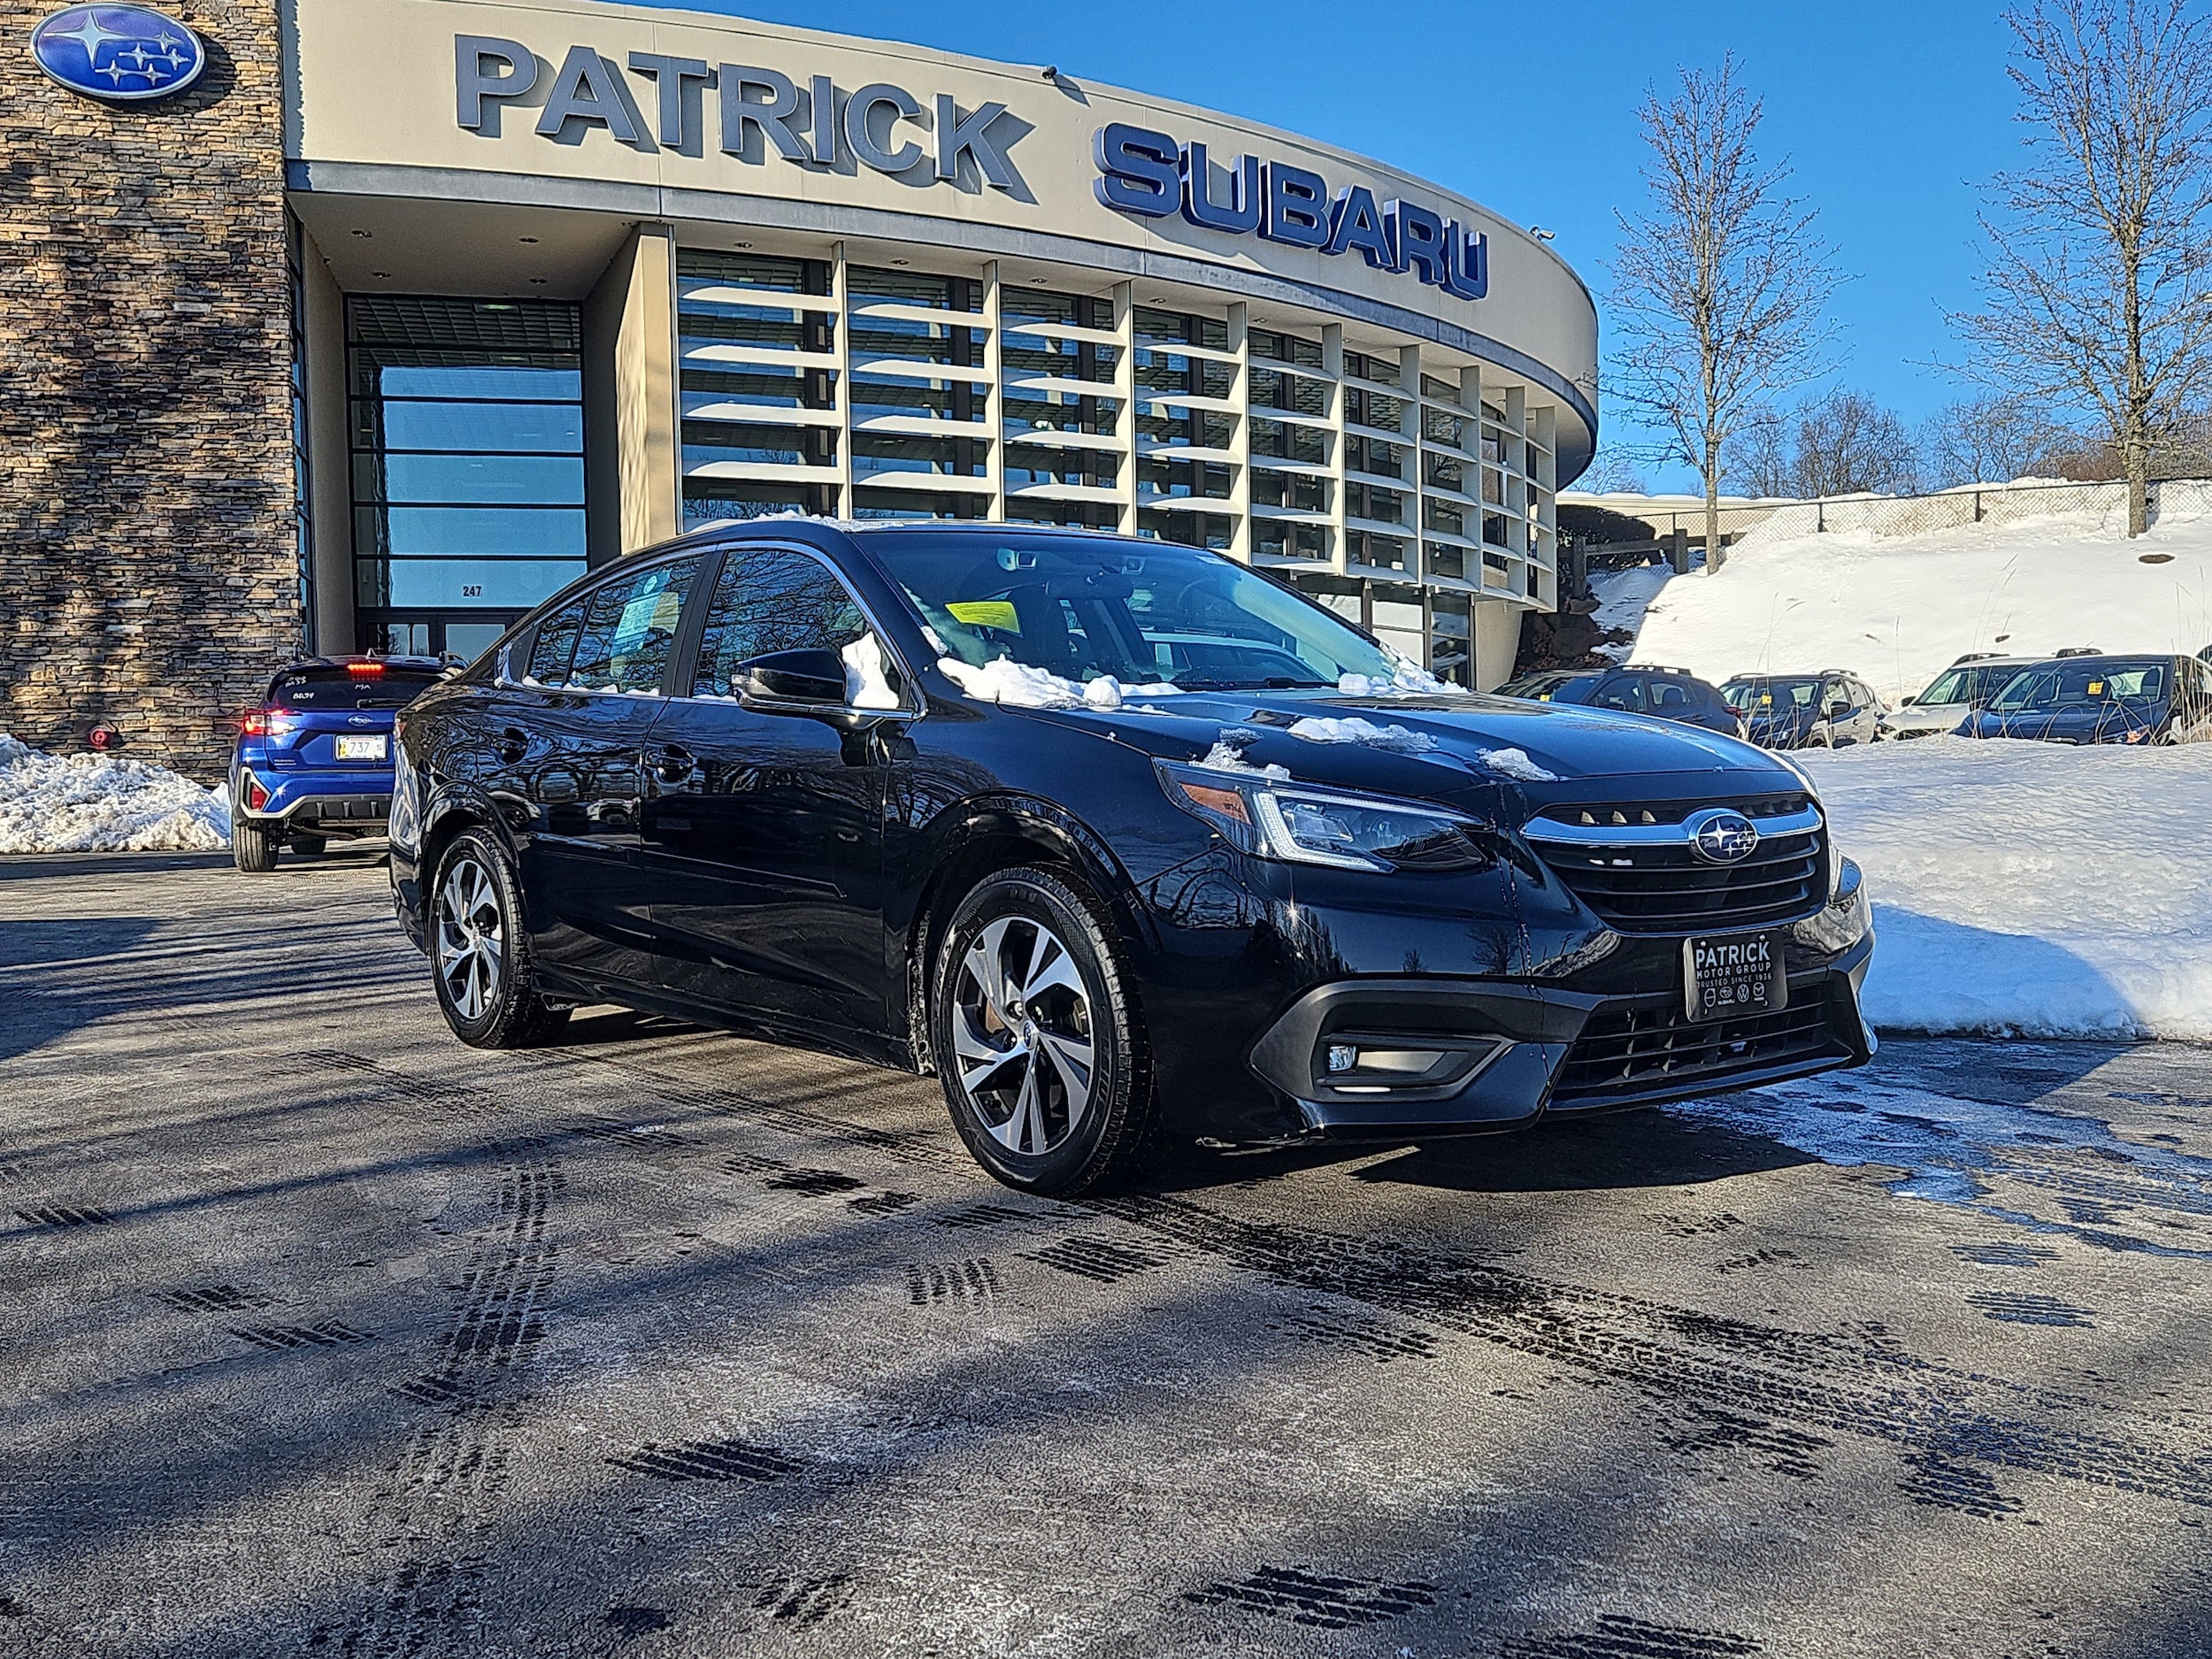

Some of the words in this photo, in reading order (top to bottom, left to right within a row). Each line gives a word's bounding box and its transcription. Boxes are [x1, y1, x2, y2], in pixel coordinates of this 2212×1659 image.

[454, 34, 1014, 189] PATRICK
[1093, 122, 1488, 301] SUBARU
[463, 585, 482, 597] 247
[349, 741, 370, 754] 737
[1695, 941, 1770, 970] PATRICK
[1696, 966, 1731, 980] MOTOR
[1736, 962, 1771, 975] GROUP
[1697, 978, 1728, 989] TRUSTED
[1731, 974, 1753, 985] SINCE
